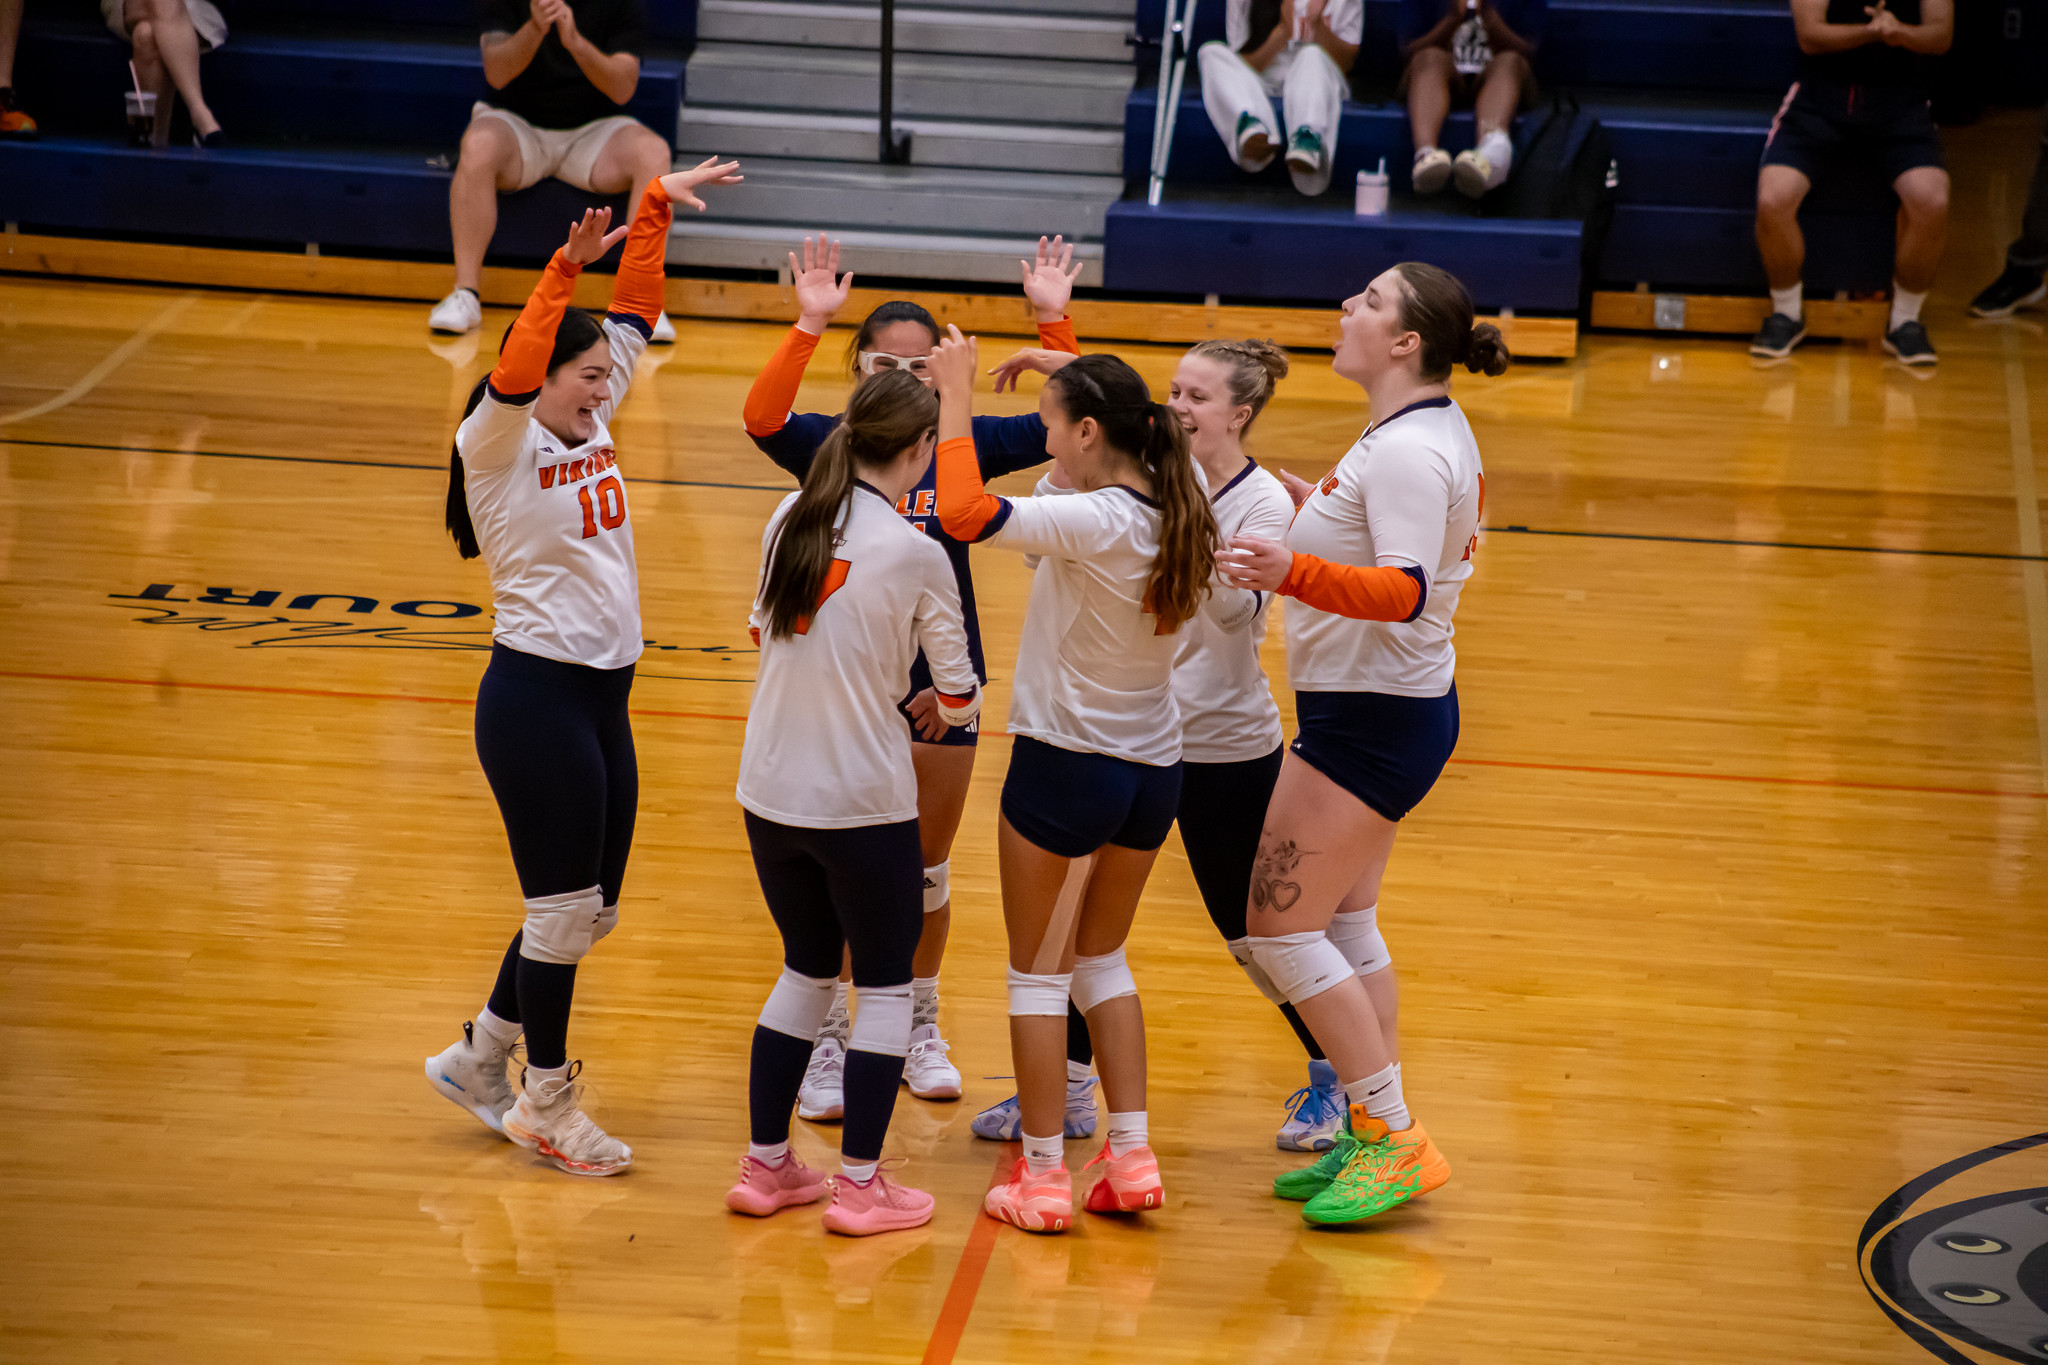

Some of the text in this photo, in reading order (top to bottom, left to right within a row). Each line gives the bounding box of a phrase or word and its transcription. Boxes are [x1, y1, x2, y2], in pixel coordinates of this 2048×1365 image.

[577, 475, 626, 540] 10
[894, 489, 939, 517] LE
[107, 583, 495, 620] OURT
